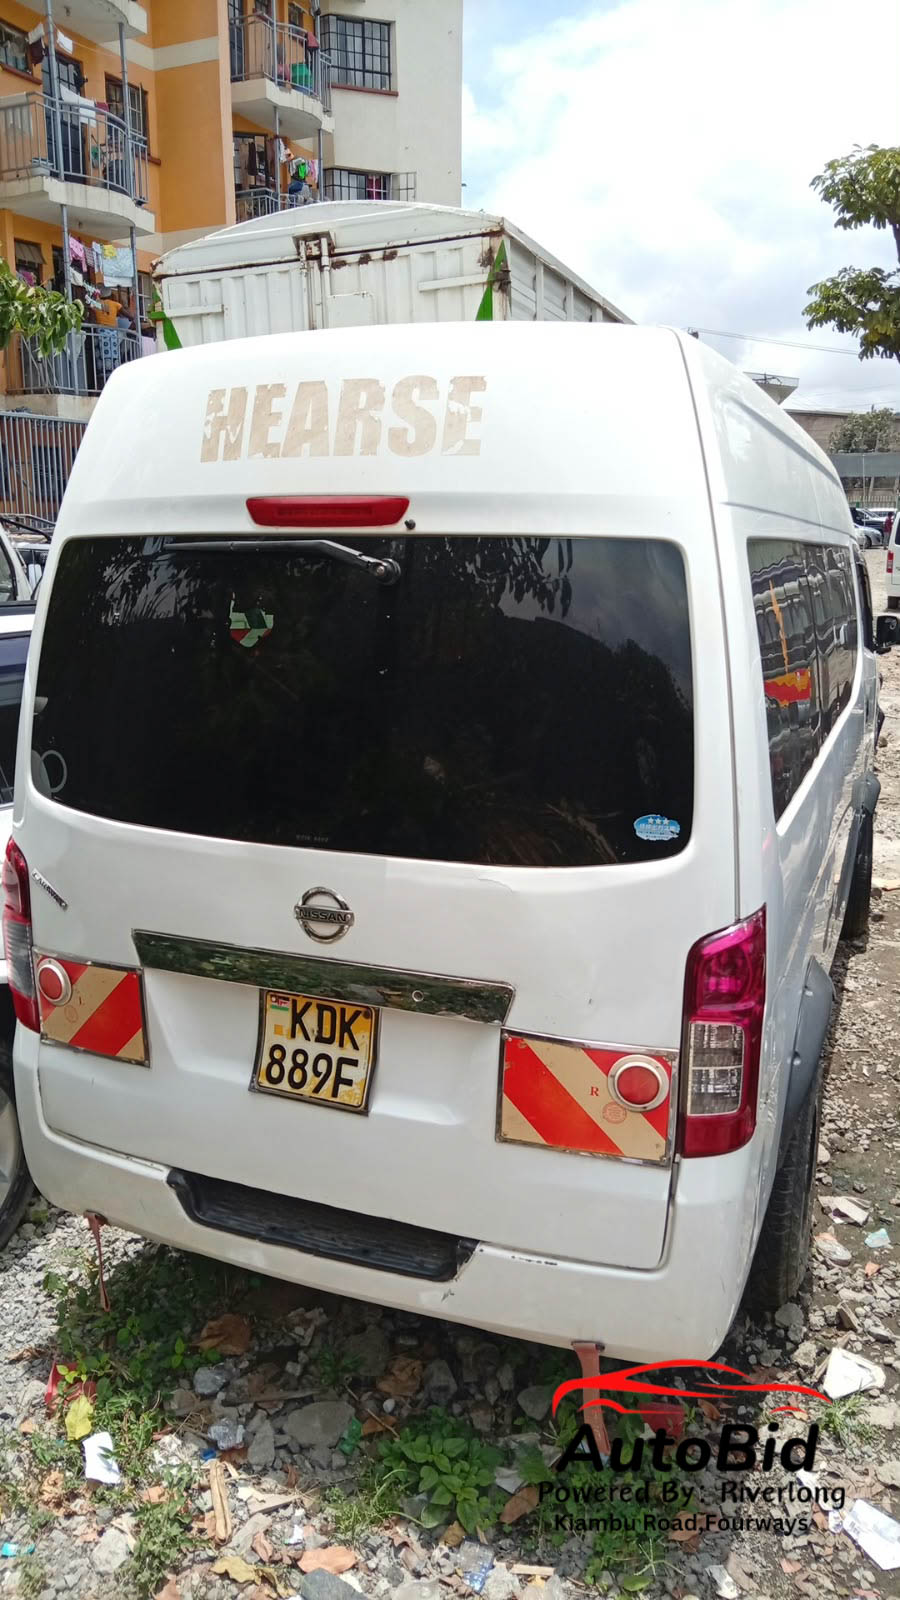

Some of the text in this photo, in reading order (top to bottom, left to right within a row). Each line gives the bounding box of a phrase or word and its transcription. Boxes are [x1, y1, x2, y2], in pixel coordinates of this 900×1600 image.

[200, 375, 487, 463] HEARSE
[299, 908, 347, 922] NISSAN
[290, 998, 362, 1051] KDK
[265, 1043, 359, 1098] 889F
[590, 1086, 600, 1097] R
